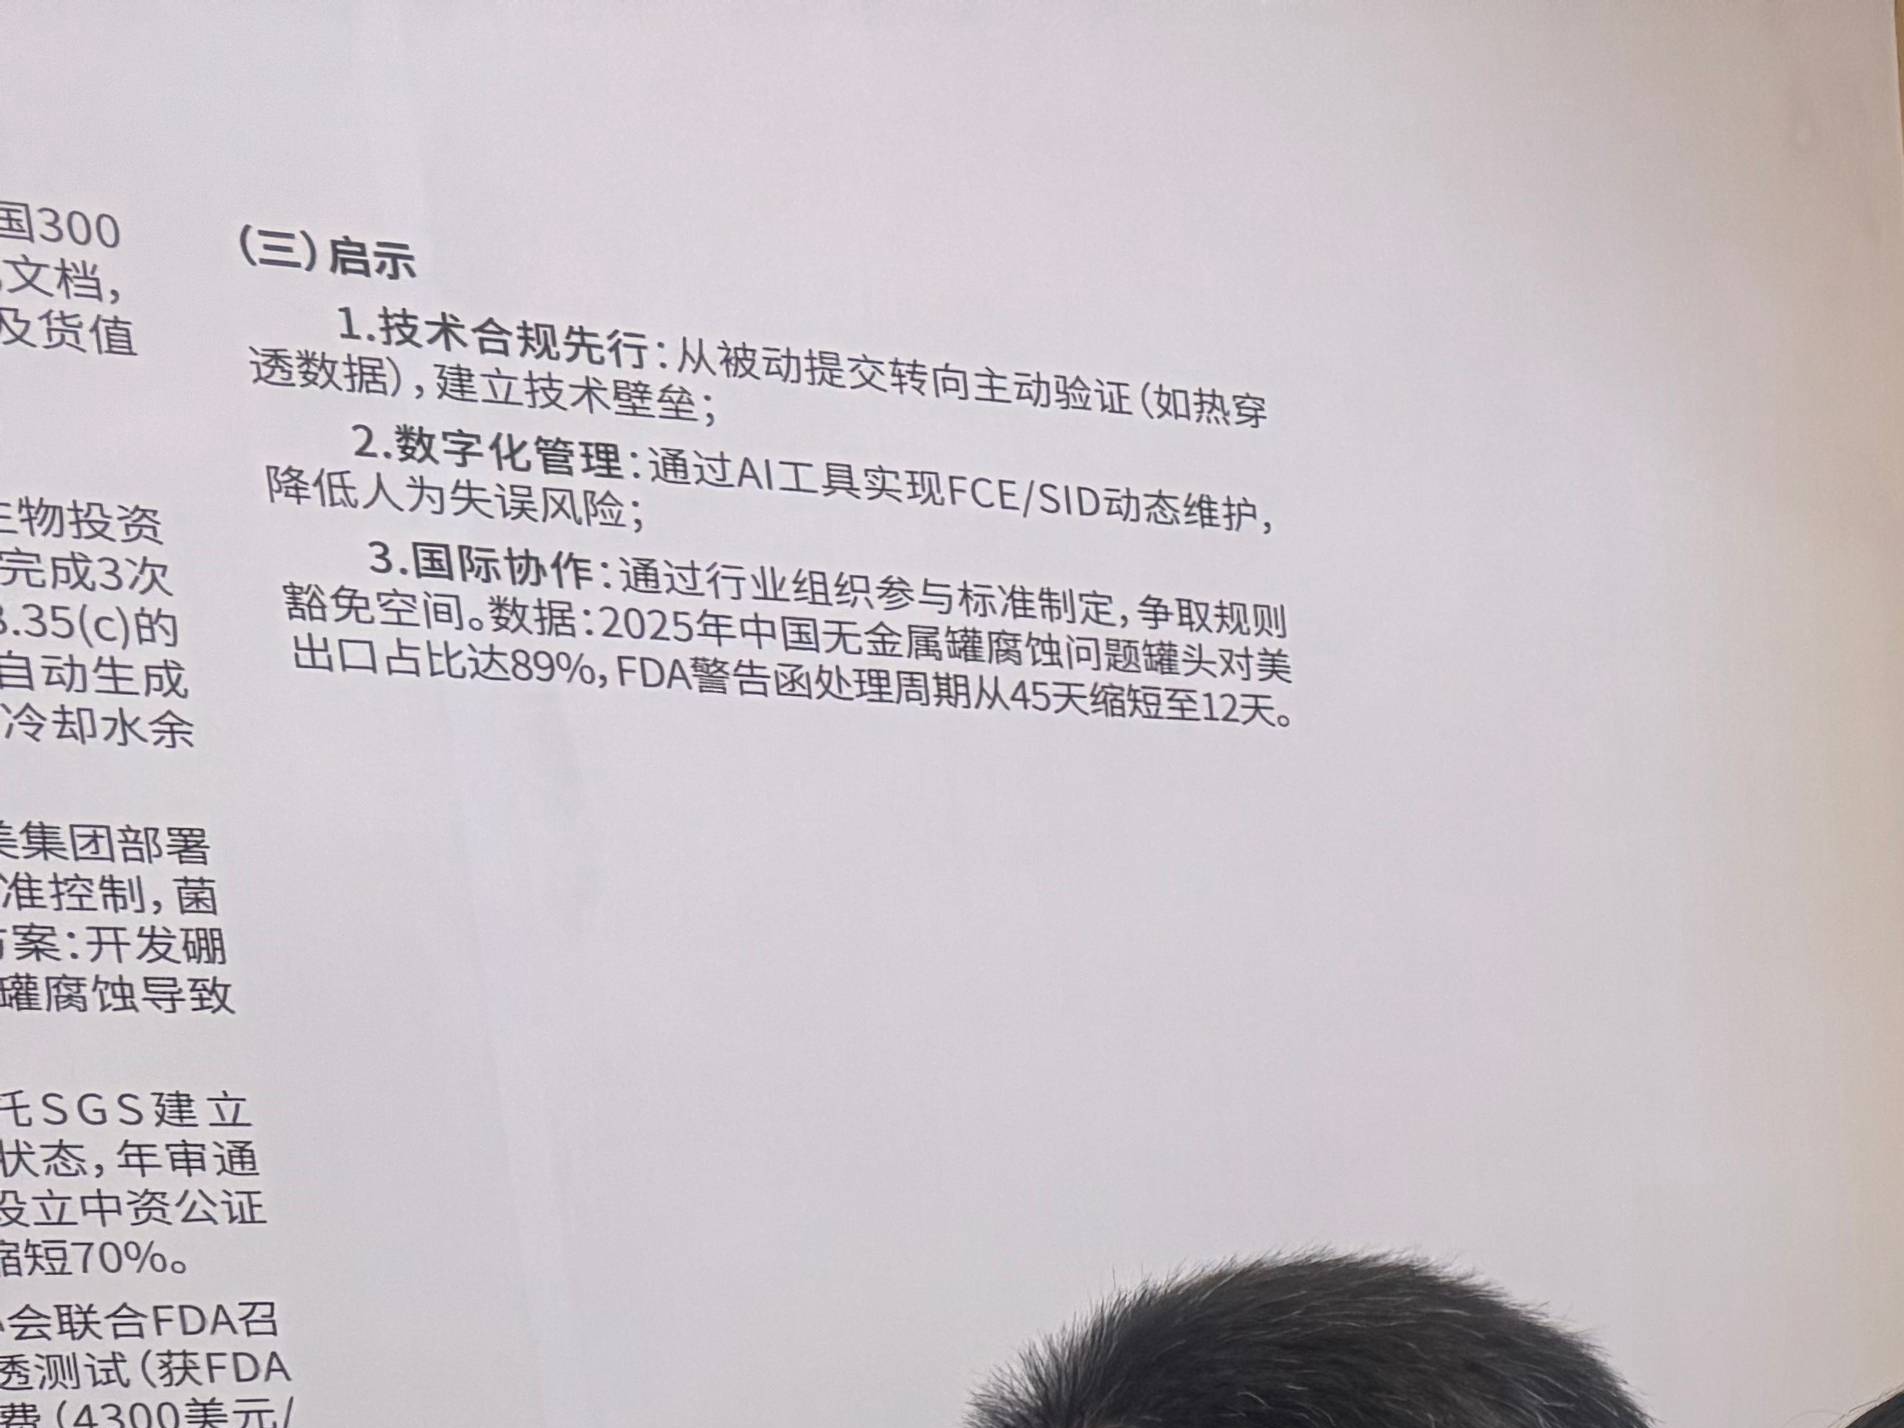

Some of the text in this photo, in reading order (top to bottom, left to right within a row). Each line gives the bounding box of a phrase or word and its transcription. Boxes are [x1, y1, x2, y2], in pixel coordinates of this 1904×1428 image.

[0, 254, 120, 304] 文档，
[265, 466, 645, 533] 降低人为失误风险；
[0, 702, 194, 749] 冷却水余
[0, 922, 227, 965] 案：开发硼
[0, 1301, 278, 1341] 会联合FDA召
